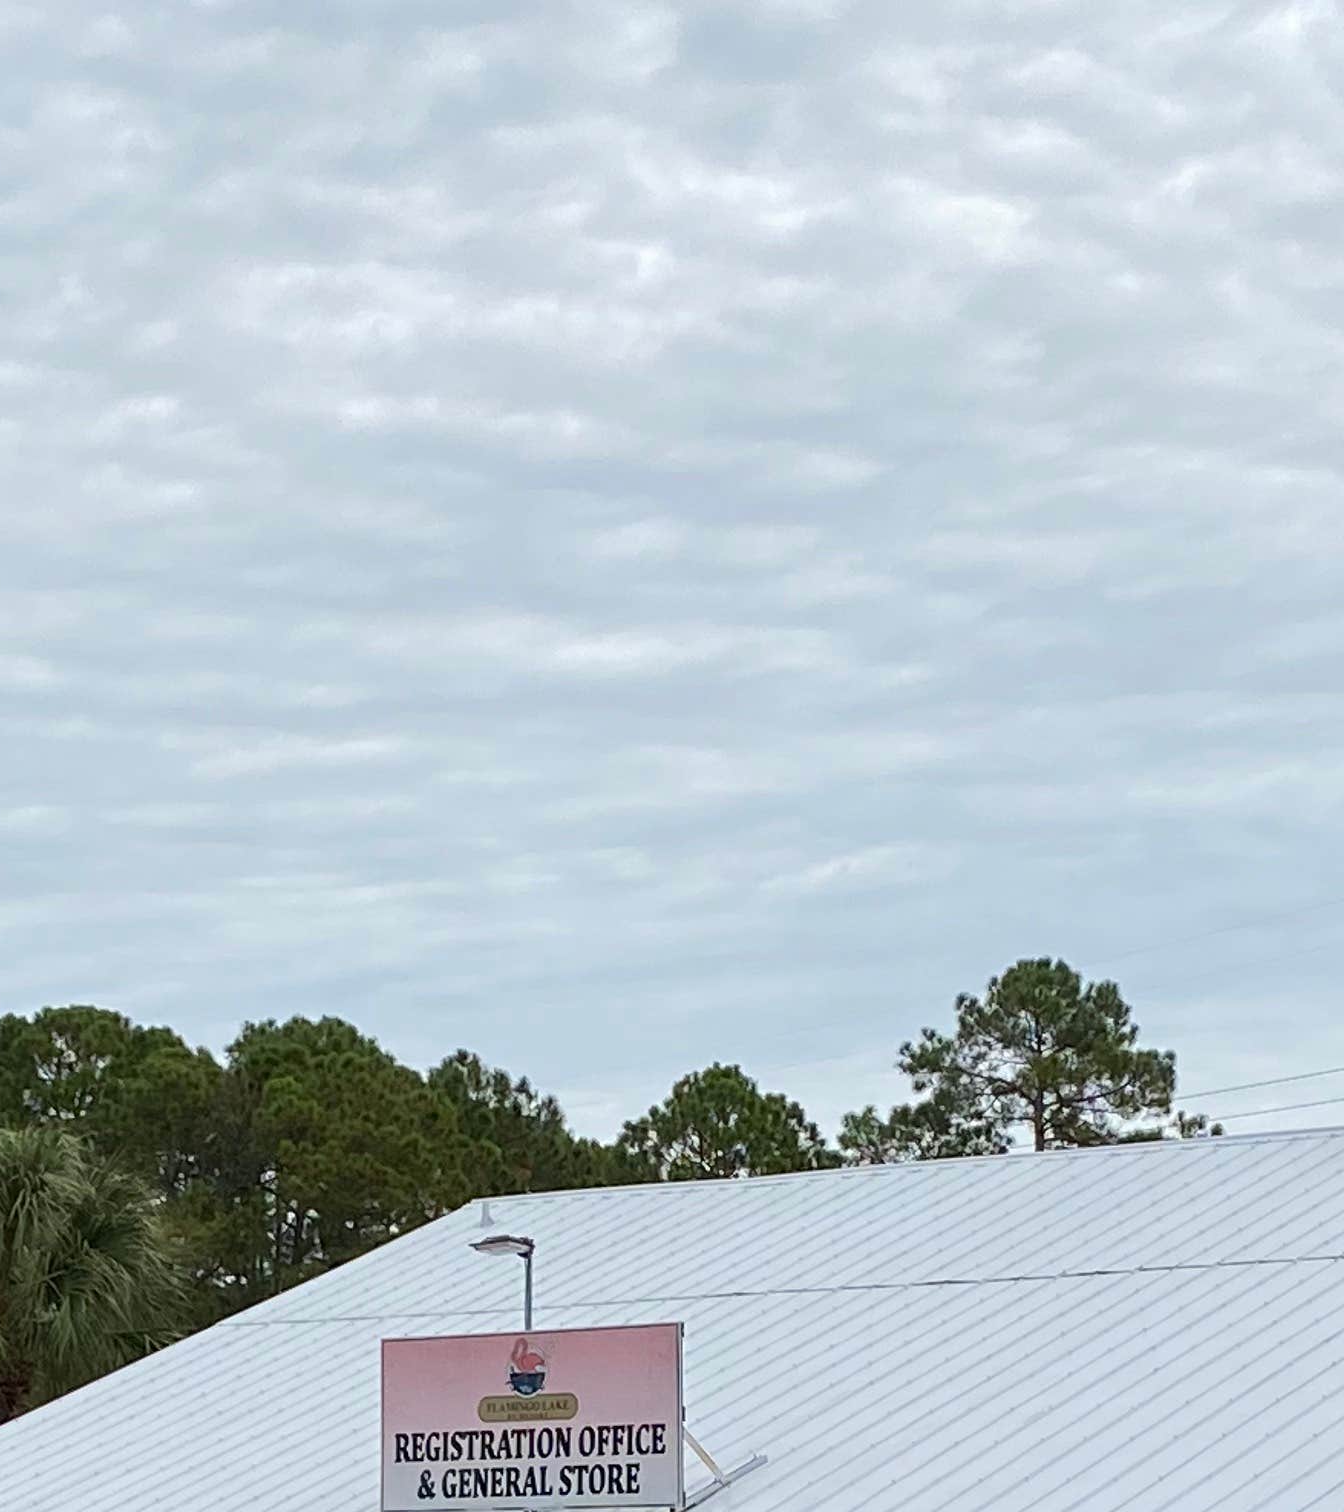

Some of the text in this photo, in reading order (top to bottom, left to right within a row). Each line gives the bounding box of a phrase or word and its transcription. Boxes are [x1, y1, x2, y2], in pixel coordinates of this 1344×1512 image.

[394, 1423, 667, 1464] REGISTRATION OFFICE
[417, 1462, 641, 1499] & GENERAL STORE
